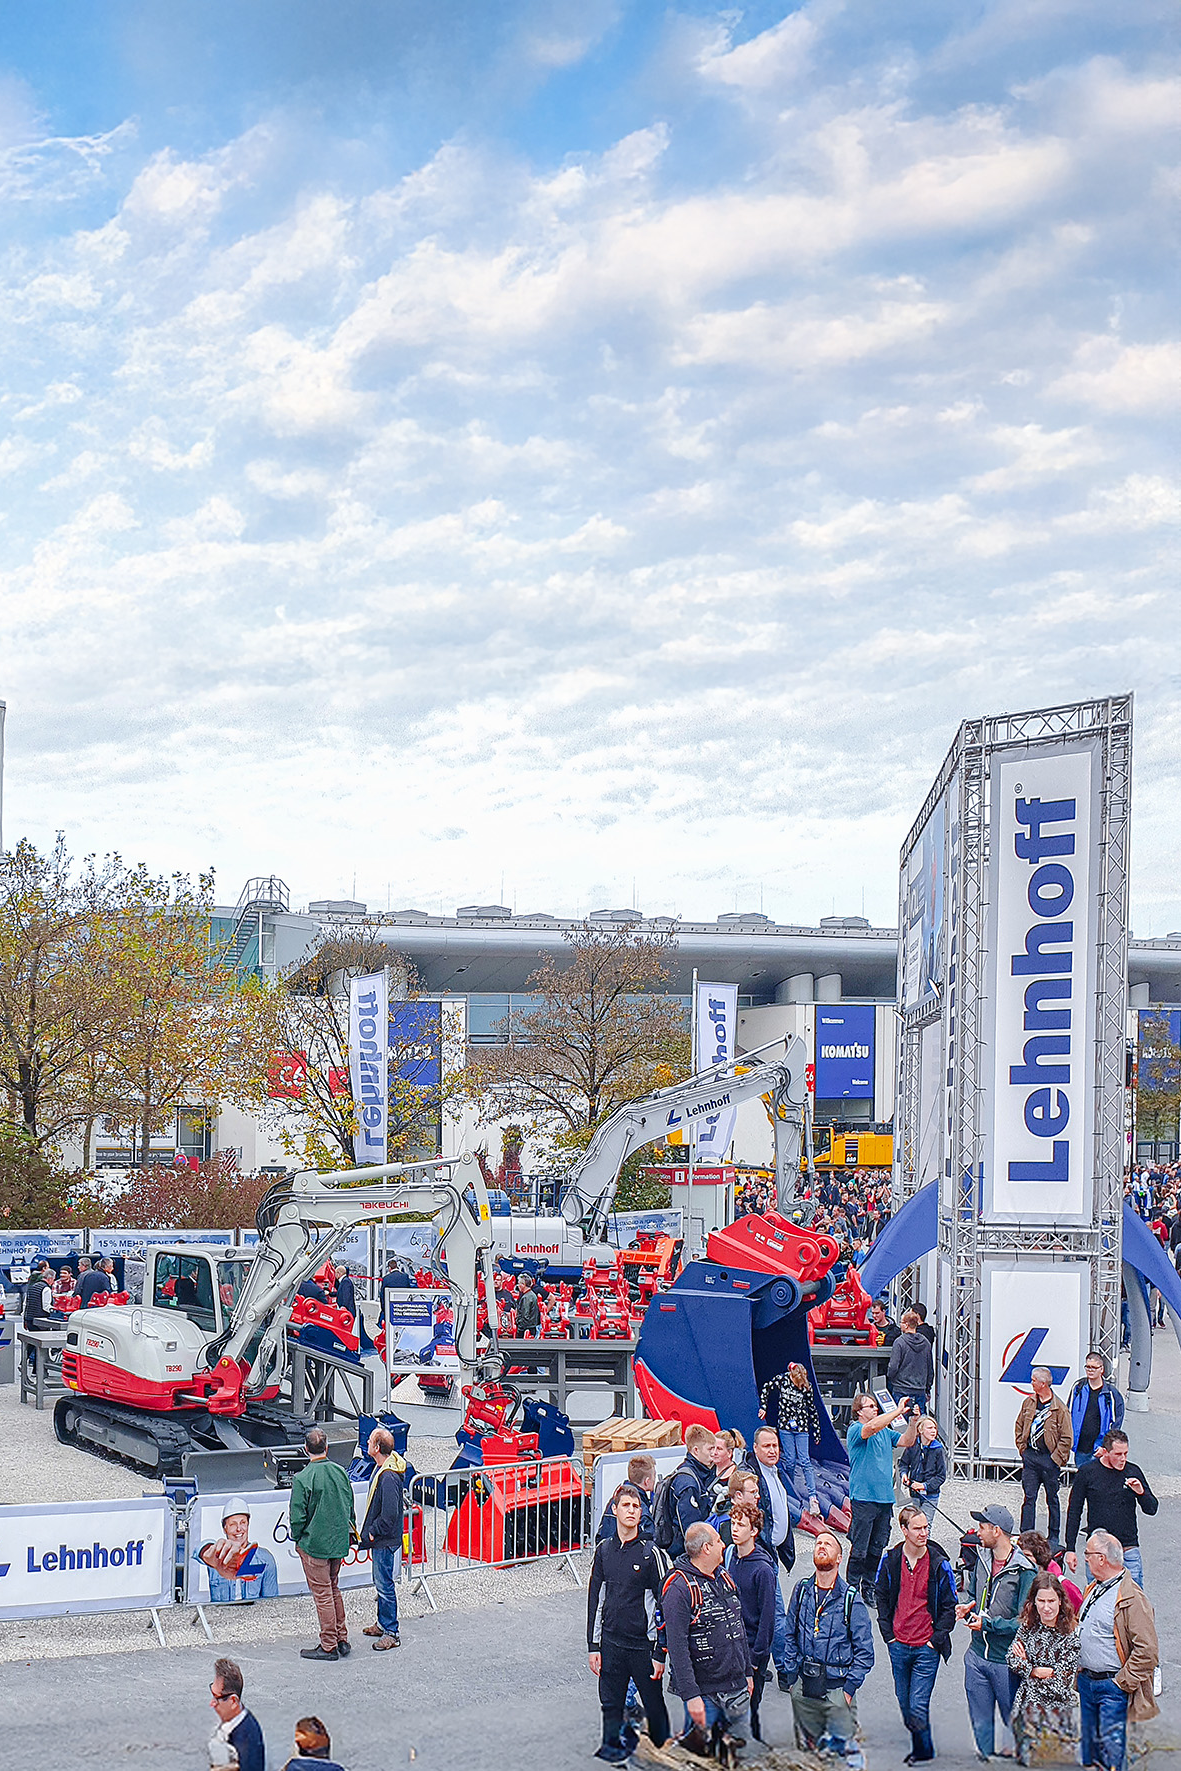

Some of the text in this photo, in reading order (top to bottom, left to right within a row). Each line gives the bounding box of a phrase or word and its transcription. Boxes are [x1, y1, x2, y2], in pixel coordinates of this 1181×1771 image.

[1007, 797, 1077, 1182] Lehnhoff
[821, 1042, 870, 1059] KOMATSU
[686, 1093, 731, 1118] Lehnhoff
[360, 1201, 409, 1209] TAKEUCHI
[515, 1242, 559, 1254] Lehnhoff
[27, 1540, 145, 1574] Lehnhoff
